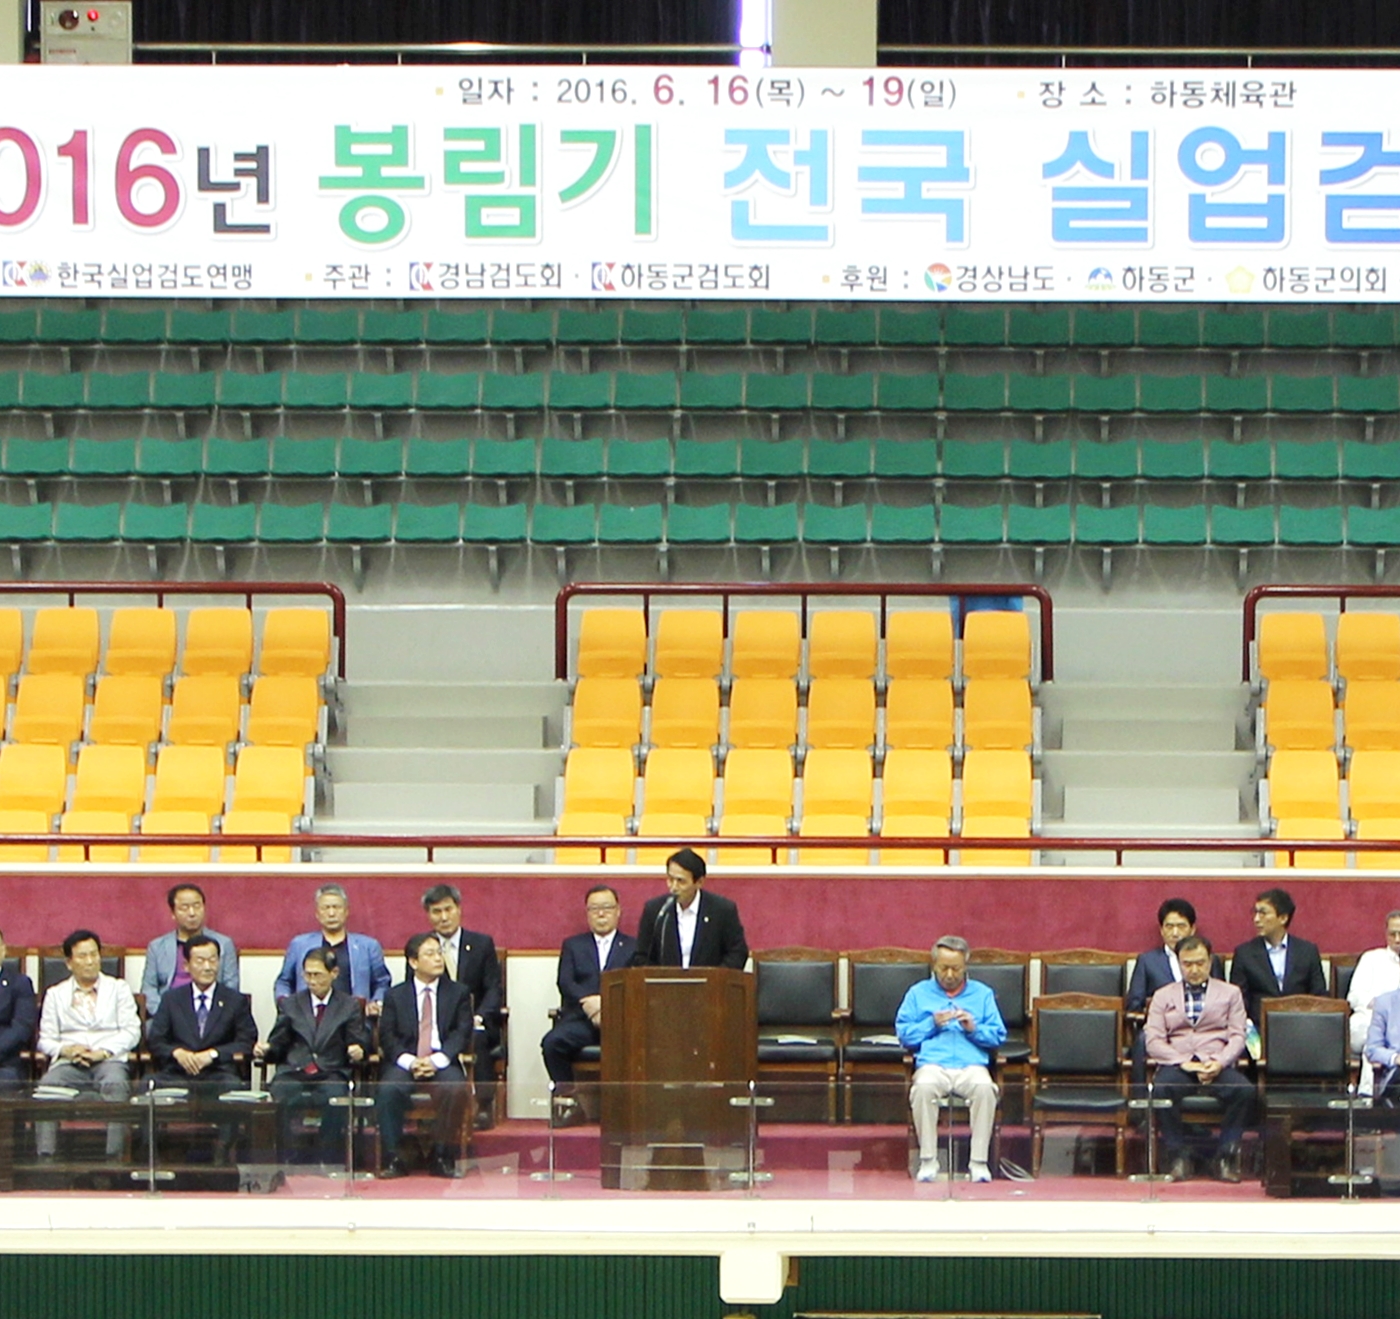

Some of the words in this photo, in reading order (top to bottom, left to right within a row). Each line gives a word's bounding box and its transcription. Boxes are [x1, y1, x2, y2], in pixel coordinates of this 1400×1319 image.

[458, 77, 515, 105] 일자
[557, 78, 637, 105] 2016.
[653, 73, 686, 106] 6.
[707, 74, 805, 108] 16(목)
[862, 75, 958, 109] 19(일)
[1150, 80, 1297, 109] 하동체육관
[318, 123, 652, 245] 봉림기
[724, 128, 970, 243] 전국
[57, 262, 253, 291] 한국실업검도연맹
[323, 263, 372, 290] 주관
[439, 262, 562, 290] 경남검도회
[621, 262, 771, 291] 하동군검도회
[841, 265, 888, 293] 후원
[956, 265, 1055, 293] 경상남도
[1122, 265, 1195, 293] 하동군
[1262, 266, 1387, 295] 하동군의회
